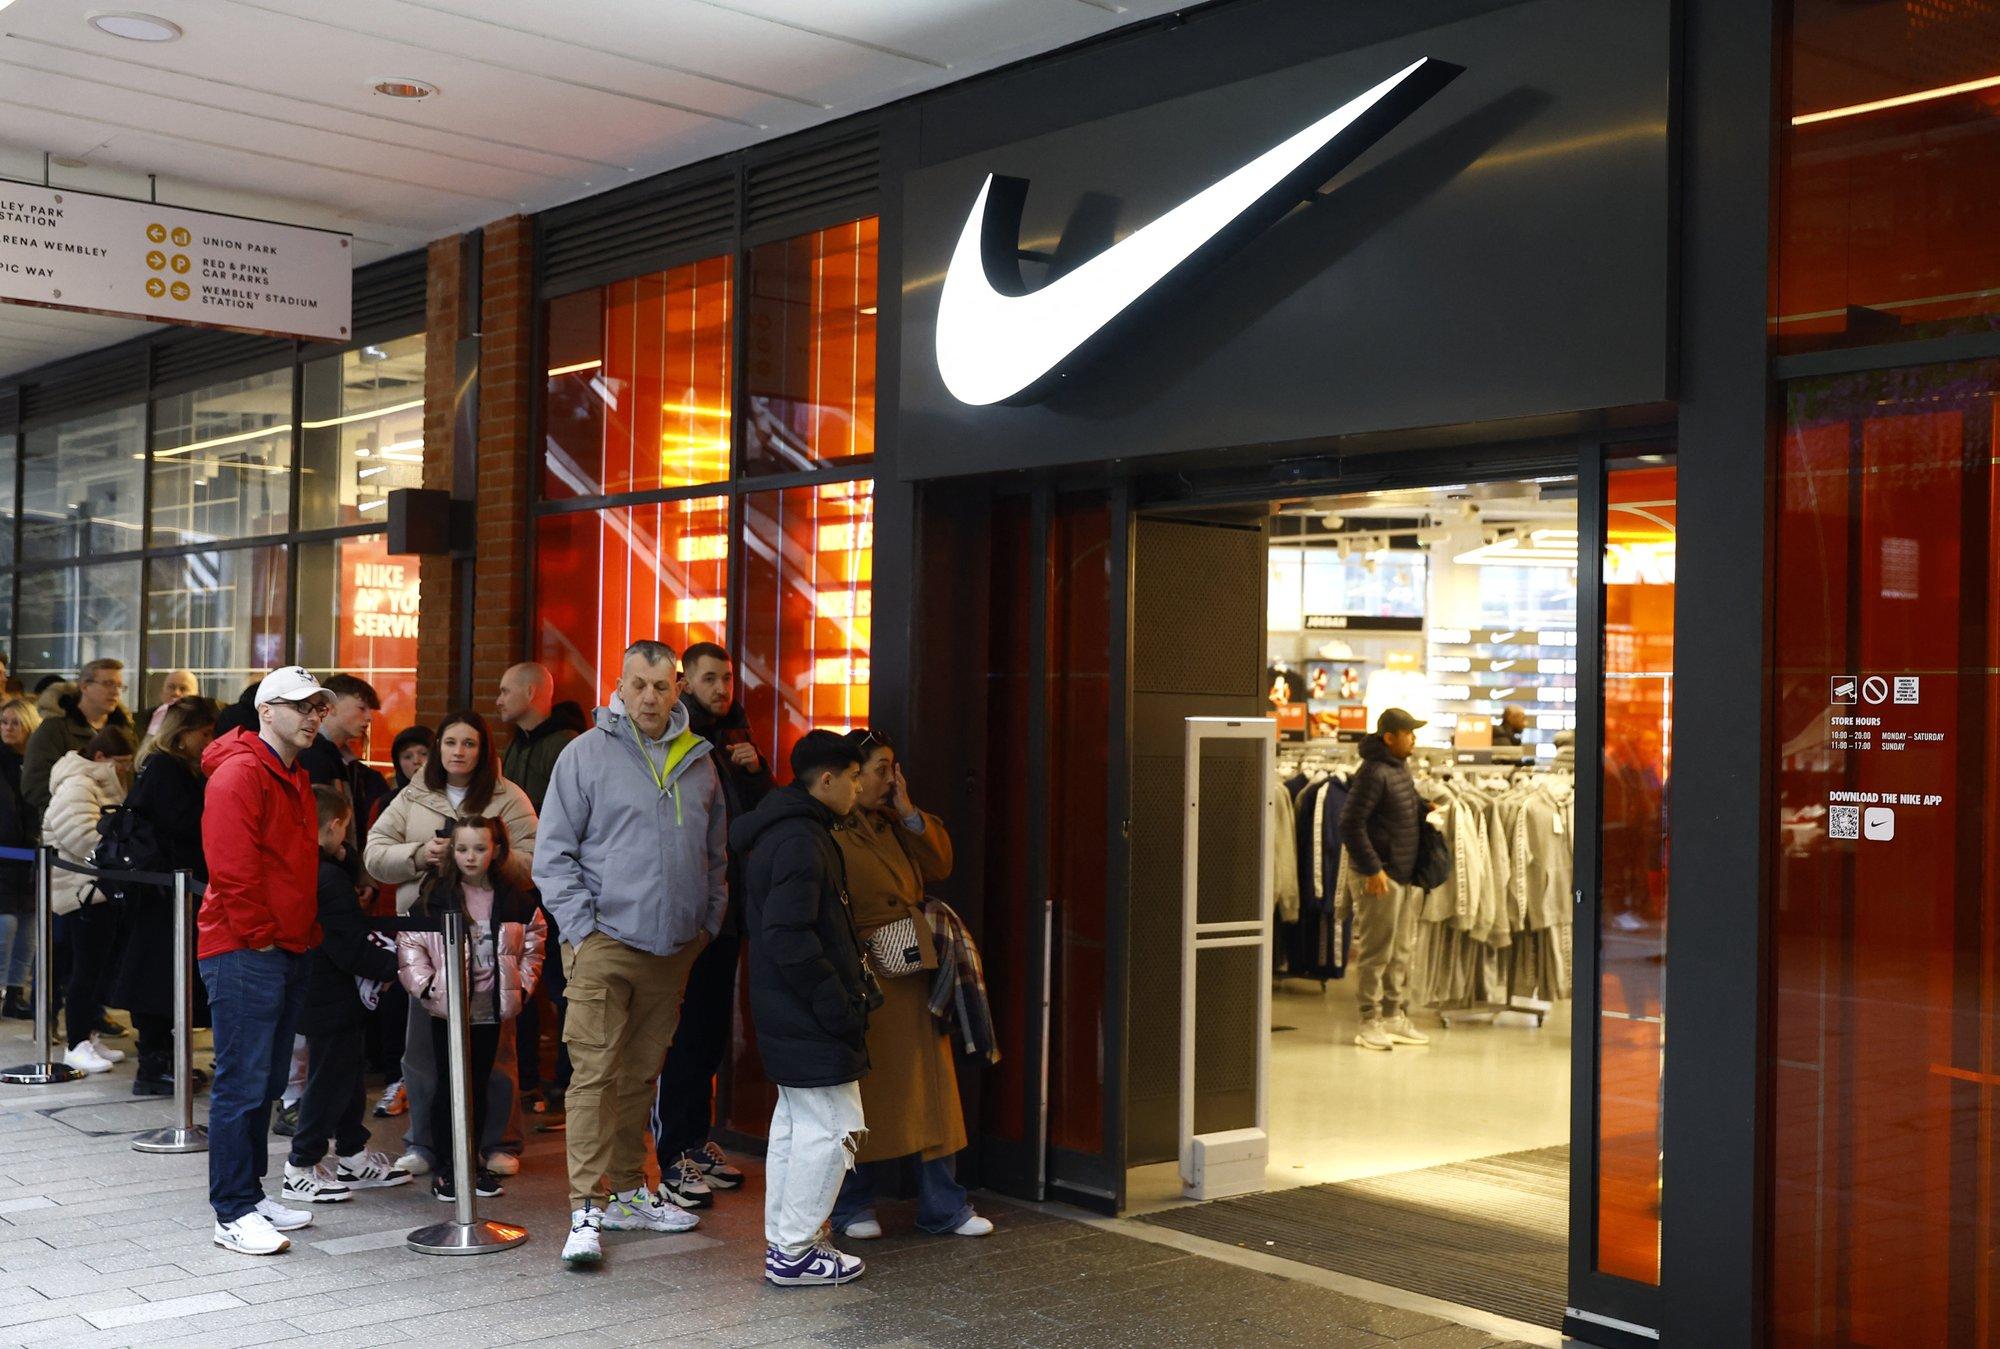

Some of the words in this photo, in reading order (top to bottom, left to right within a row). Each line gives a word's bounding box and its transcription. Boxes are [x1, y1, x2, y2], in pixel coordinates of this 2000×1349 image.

[0, 201, 24, 212] LEY
[30, 205, 64, 218] PARK
[0, 211, 56, 227] STATION
[3, 235, 38, 248] RENA
[44, 240, 107, 257] WEMBLEY
[203, 236, 242, 250] UNION
[247, 243, 277, 255] PARK
[0, 262, 19, 274] PIC
[25, 266, 54, 278] WAY
[203, 258, 226, 270] RED
[230, 260, 236, 270] &
[240, 263, 268, 275] PINK
[202, 268, 226, 280] CAR
[231, 273, 269, 286] PARKS
[202, 285, 260, 300] WEMBLEY
[265, 294, 318, 309] STADIUM
[202, 295, 254, 310] STATION
[355, 563, 404, 590] NIKE
[1831, 716, 1854, 726] STORE
[1855, 717, 1881, 726] HOURS
[1831, 731, 1847, 740] 10:00
[1881, 732, 1907, 740] MONDAY
[1913, 733, 1945, 741] SATURDAY
[1831, 741, 1847, 750] 11:00
[1854, 742, 1871, 750] 17:00
[1881, 742, 1906, 751] SUNDAY
[1829, 791, 1879, 803] DOWNLOAD
[1881, 793, 1898, 804] THE
[1900, 794, 1921, 805] NIKE
[1923, 795, 1943, 806] APP
